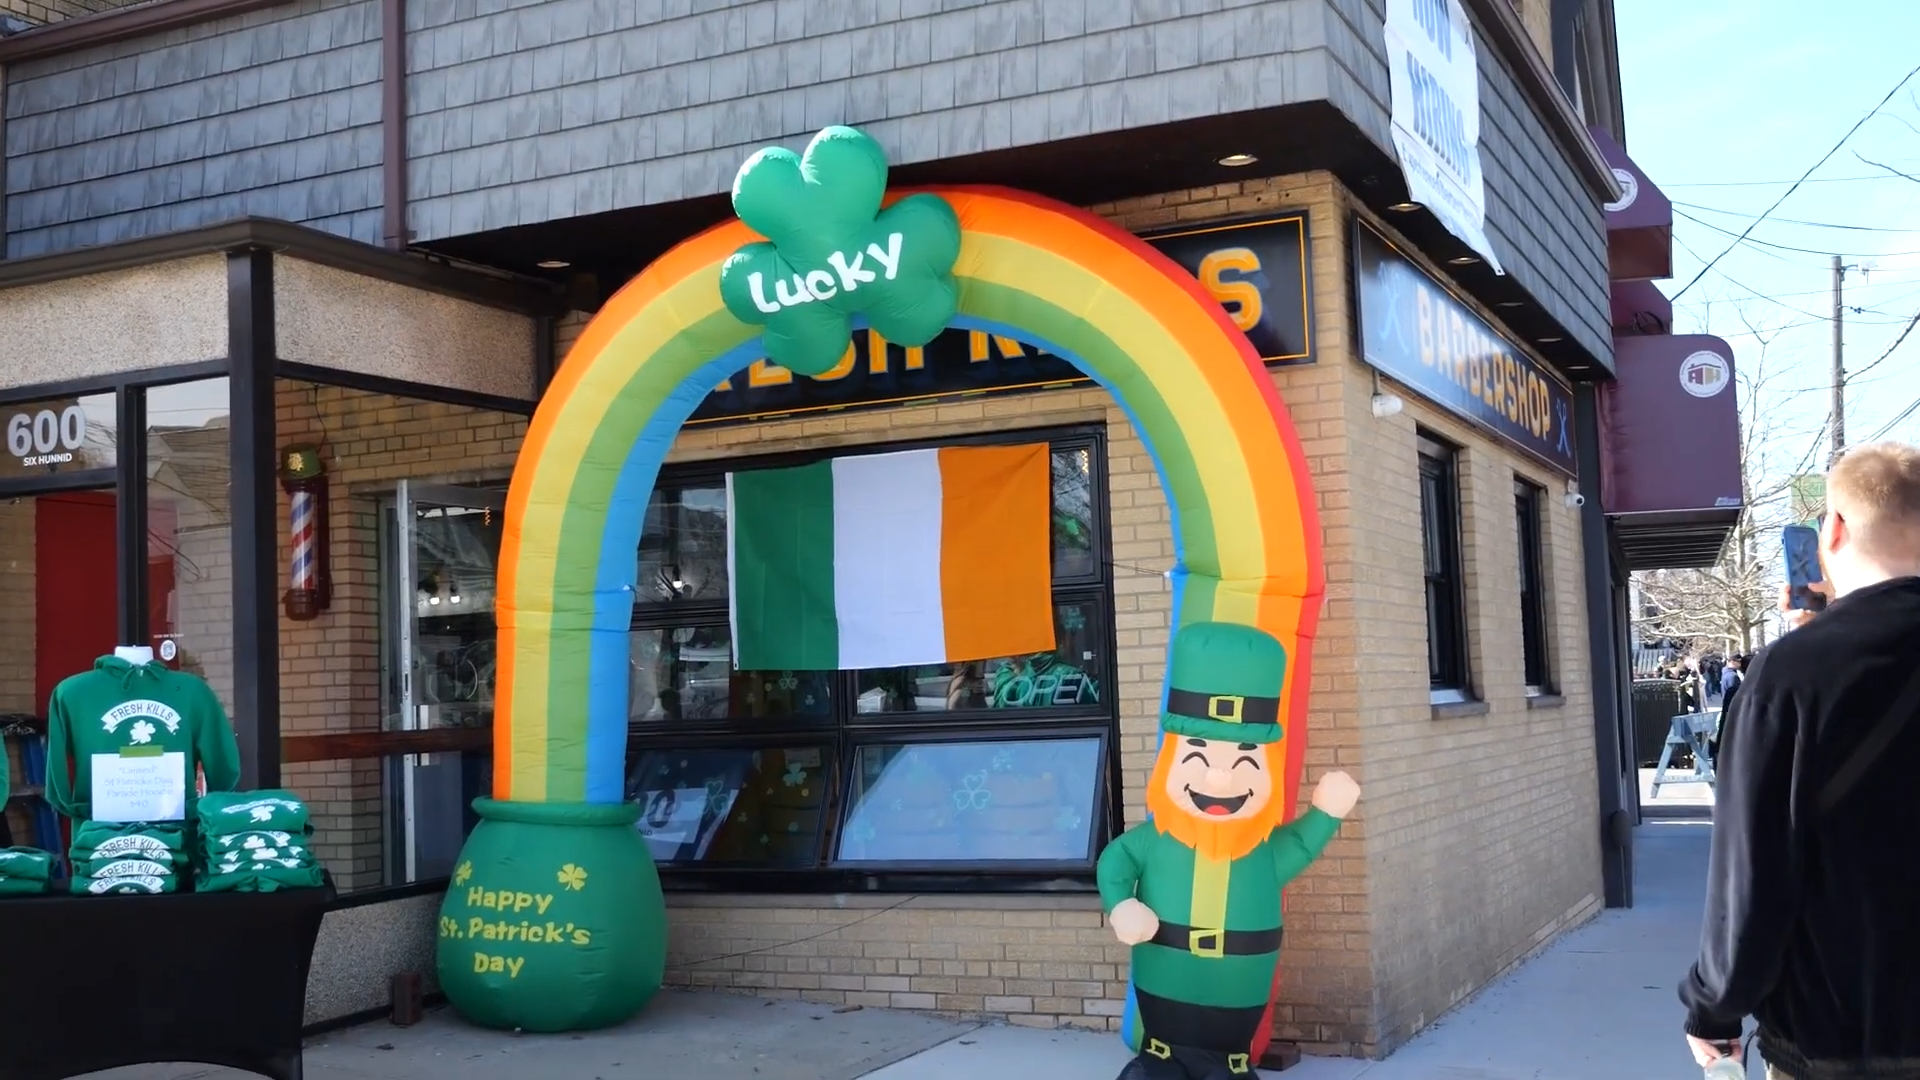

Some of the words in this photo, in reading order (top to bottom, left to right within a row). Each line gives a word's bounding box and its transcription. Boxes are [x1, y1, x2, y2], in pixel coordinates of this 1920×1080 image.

[746, 232, 903, 313] Lucky
[1417, 282, 1552, 442] BARBERSHOP
[8, 405, 86, 457] 600
[23, 456, 37, 466] SIX
[38, 453, 73, 464] HUNNID
[1002, 673, 1099, 706] OPEN
[110, 702, 143, 721] FRESH
[146, 702, 174, 720] KILLS
[467, 886, 554, 914] Happy
[440, 916, 464, 939] St.
[468, 917, 592, 945] Patrick's
[474, 952, 525, 979] Day
